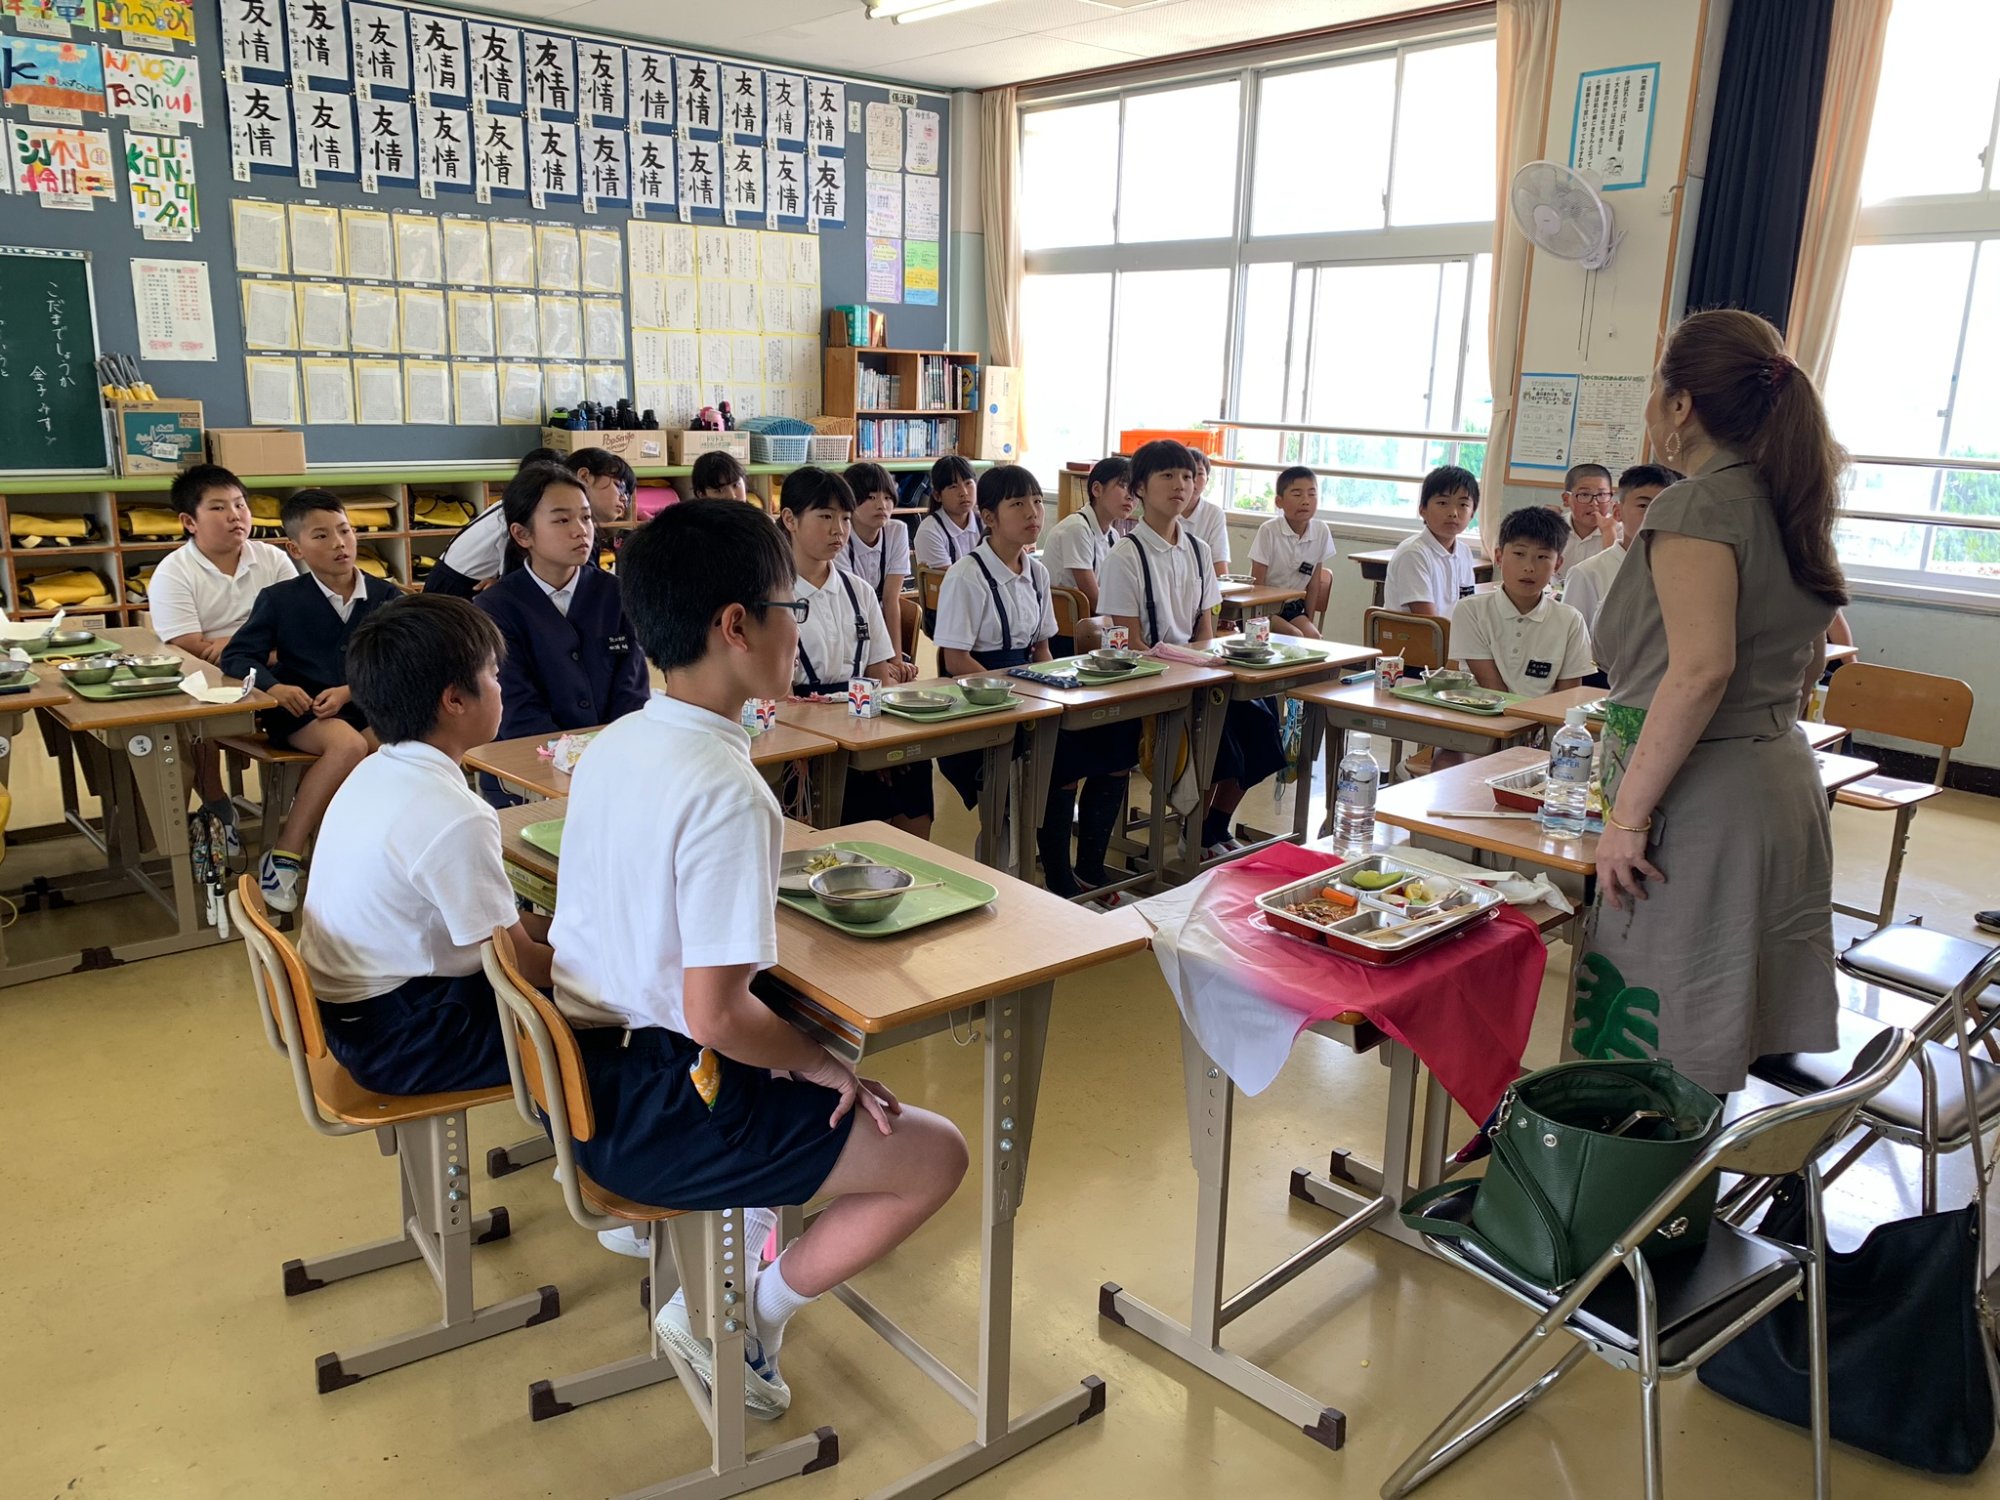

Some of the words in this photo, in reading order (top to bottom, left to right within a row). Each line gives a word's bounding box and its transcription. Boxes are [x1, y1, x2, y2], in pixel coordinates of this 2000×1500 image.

[238, 0, 272, 64] 友情
[300, 0, 336, 66] 友情
[367, 16, 398, 80] 友情
[423, 19, 459, 90] 友情
[479, 26, 514, 101] 友情
[533, 37, 570, 110] 友情
[587, 48, 616, 114] 友情
[639, 54, 670, 120] 友情
[685, 61, 712, 127] 友情
[731, 70, 757, 133] 友情
[775, 77, 796, 135] 友情
[242, 87, 282, 157] 友情
[309, 96, 342, 169] 友情
[369, 104, 404, 173] 友情
[432, 109, 461, 179] 友情
[816, 85, 838, 143] 友情
[480, 117, 514, 186] 友情
[540, 124, 568, 192] 友情
[591, 134, 621, 197] 友情
[639, 140, 666, 198] 友情
[688, 145, 714, 206] 友情
[733, 148, 758, 206] 友情
[776, 153, 800, 215] 友情
[811, 159, 840, 218] 友情
[46, 281, 76, 388] こだまでしょうか
[852, 682, 865, 693] 牛乳
